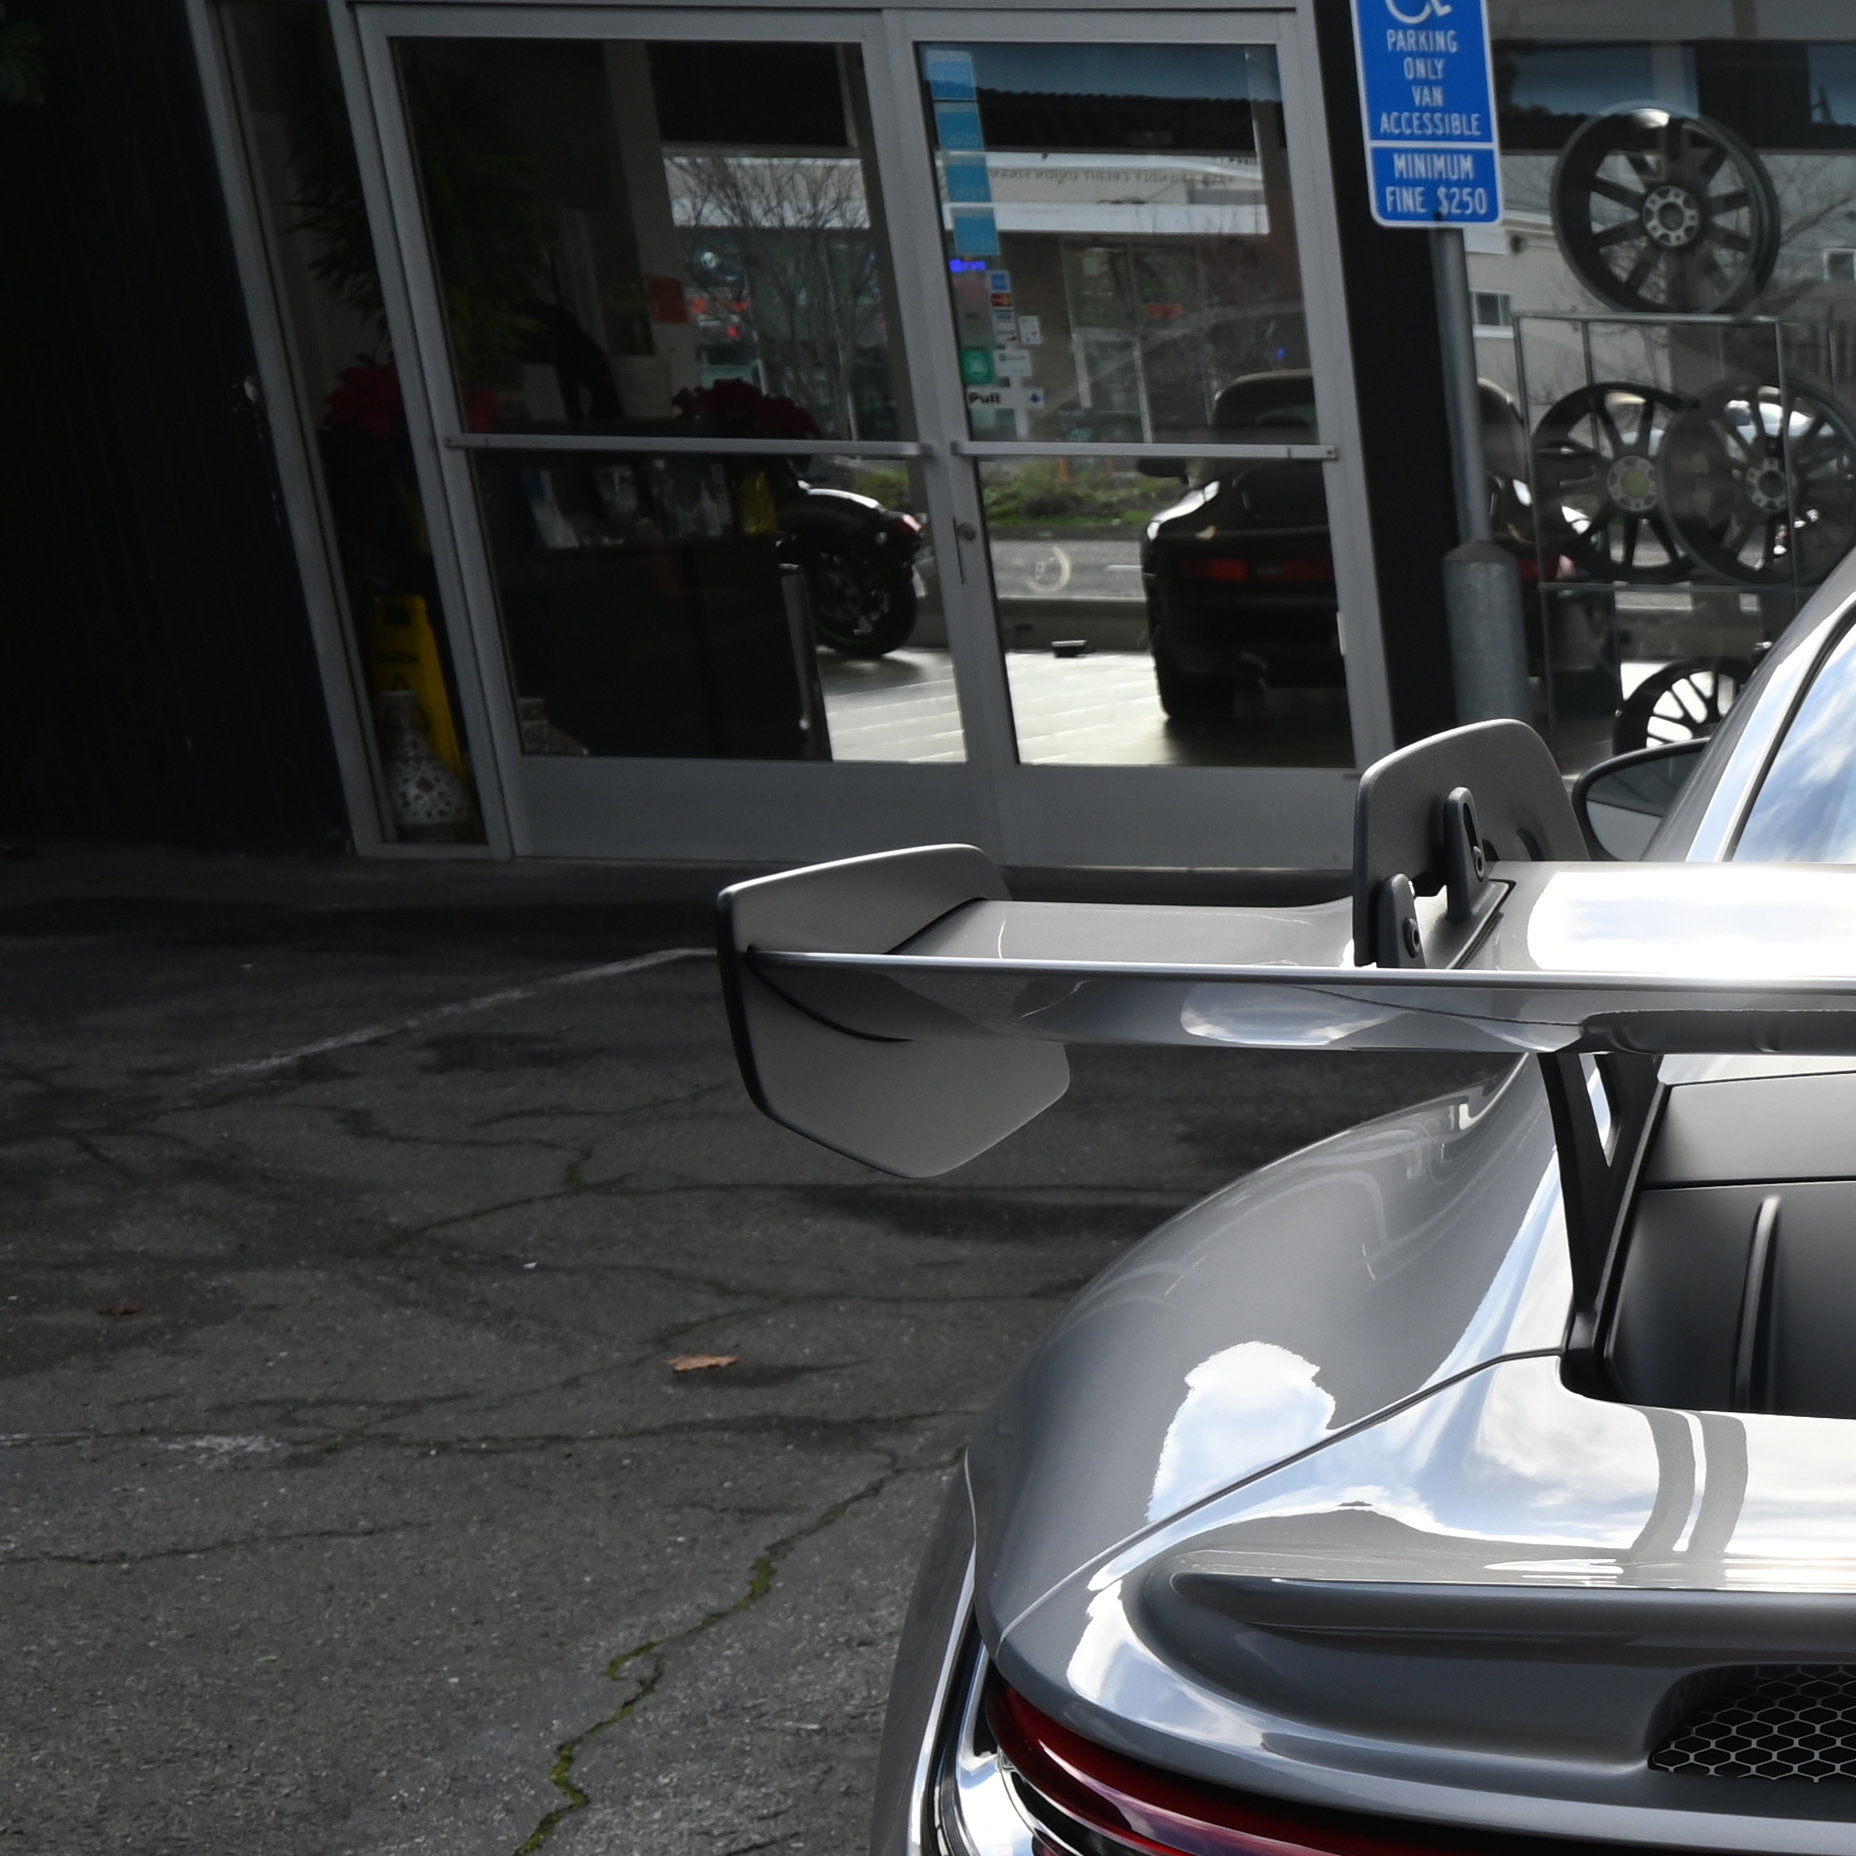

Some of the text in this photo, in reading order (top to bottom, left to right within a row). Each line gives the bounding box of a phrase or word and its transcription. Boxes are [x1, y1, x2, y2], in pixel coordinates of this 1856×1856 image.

[1386, 29, 1458, 52] PARKING
[1403, 57, 1444, 80] ONLY
[1411, 85, 1444, 106] VAN
[1380, 112, 1482, 136] ACCESSIBLE
[1393, 153, 1475, 180] MINIMUM
[1385, 186, 1488, 215] FINE $250
[968, 392, 1001, 404] Pull
